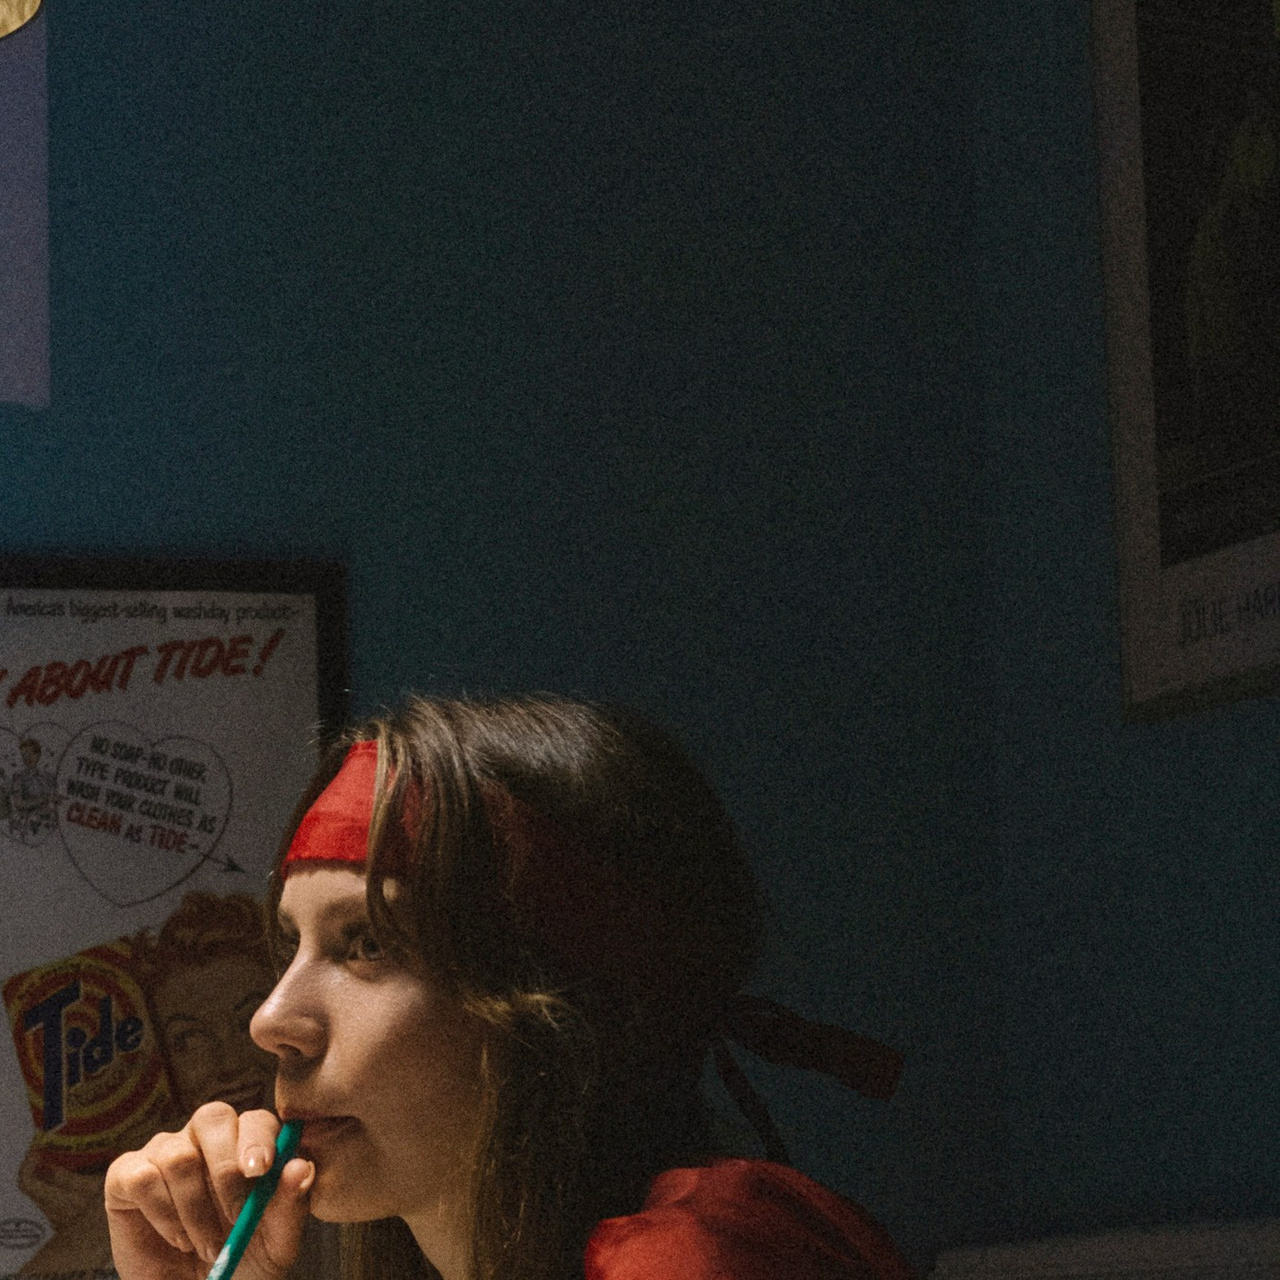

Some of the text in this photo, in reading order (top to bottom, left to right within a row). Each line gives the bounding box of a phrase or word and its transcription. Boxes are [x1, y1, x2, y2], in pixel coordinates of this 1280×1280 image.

[5, 645, 149, 710] ABOUT
[152, 627, 286, 686] TIDE!
[89, 735, 110, 756] NO
[67, 778, 217, 835] WASH YOUR CLOTHES AS
[76, 755, 202, 807] TYPE PRODUCT WILL
[66, 800, 123, 836] CLEAN
[124, 822, 144, 845] AS
[23, 978, 145, 1132] Tide
